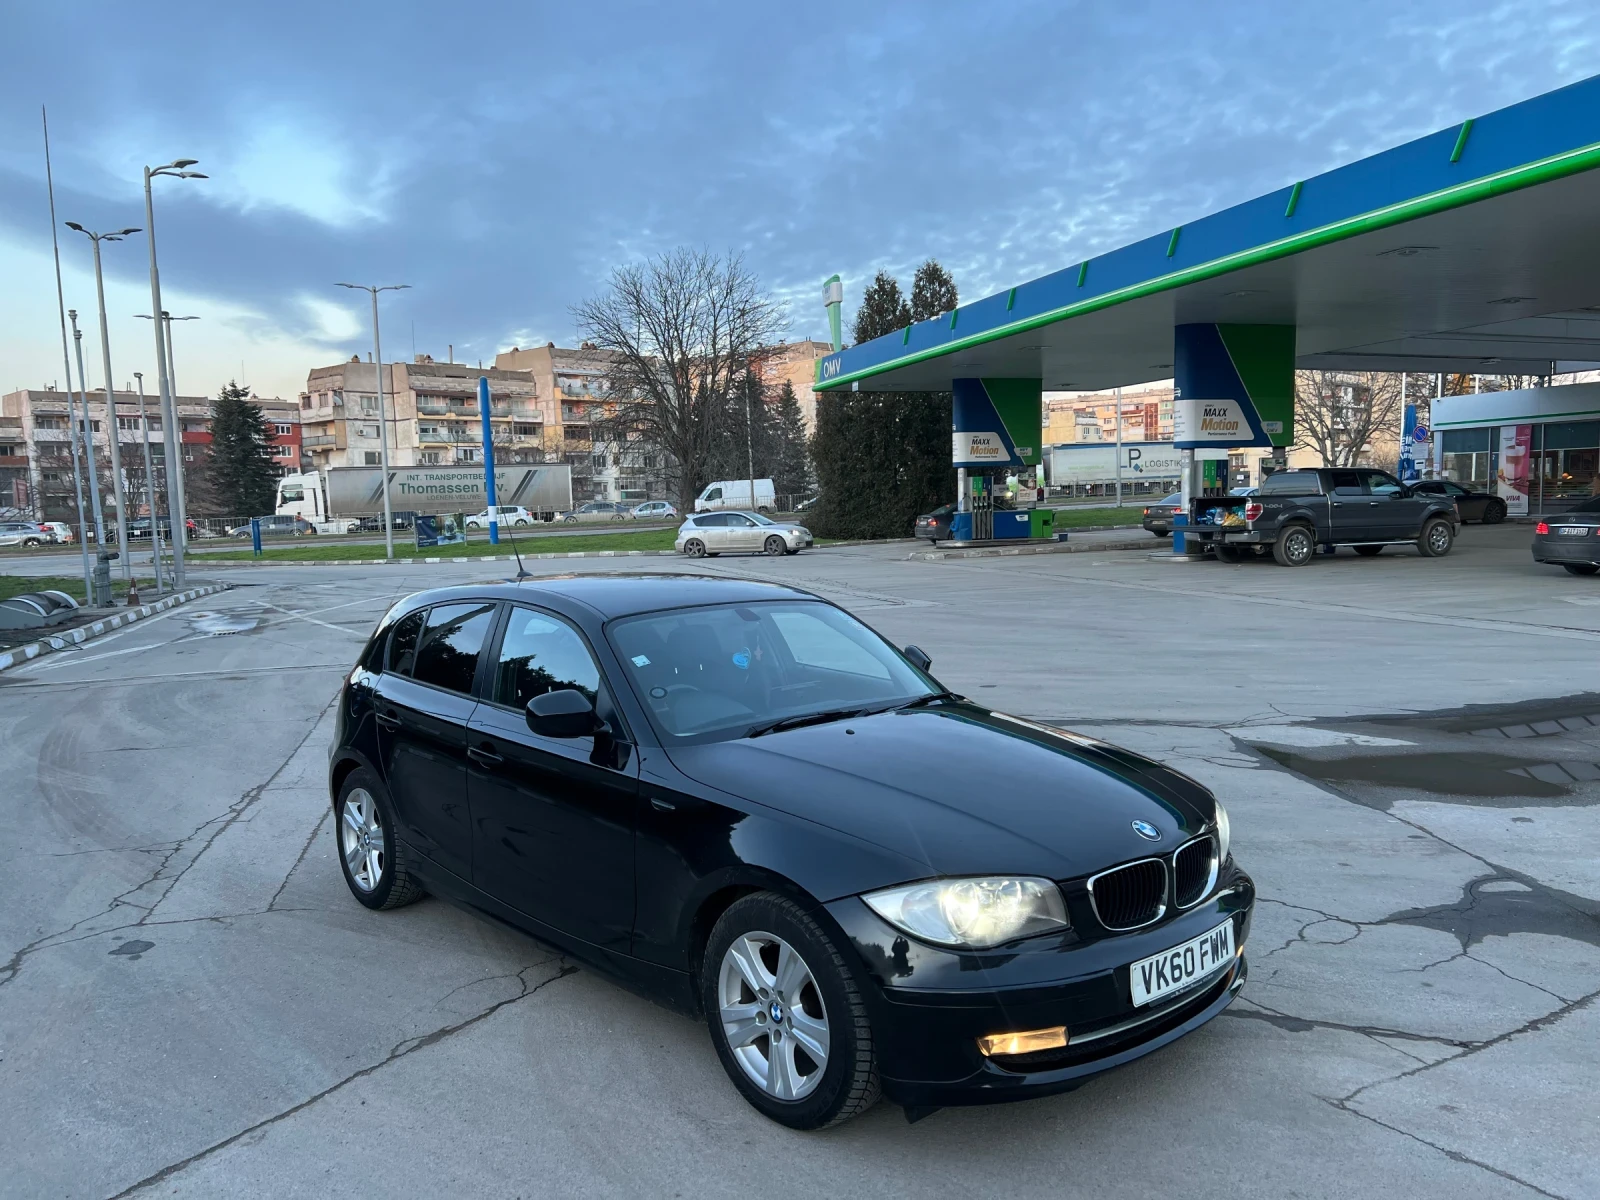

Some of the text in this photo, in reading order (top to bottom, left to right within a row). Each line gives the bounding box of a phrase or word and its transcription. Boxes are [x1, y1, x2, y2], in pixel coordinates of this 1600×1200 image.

[823, 358, 840, 377] OMV
[1203, 408, 1228, 417] MAXX
[1201, 417, 1239, 431] Motion
[970, 446, 999, 455] Motion
[424, 473, 505, 481] TRANSPORTBEIJF
[399, 483, 478, 494] Thomassen
[1141, 946, 1195, 995] VK60
[1199, 926, 1229, 971] FWM
